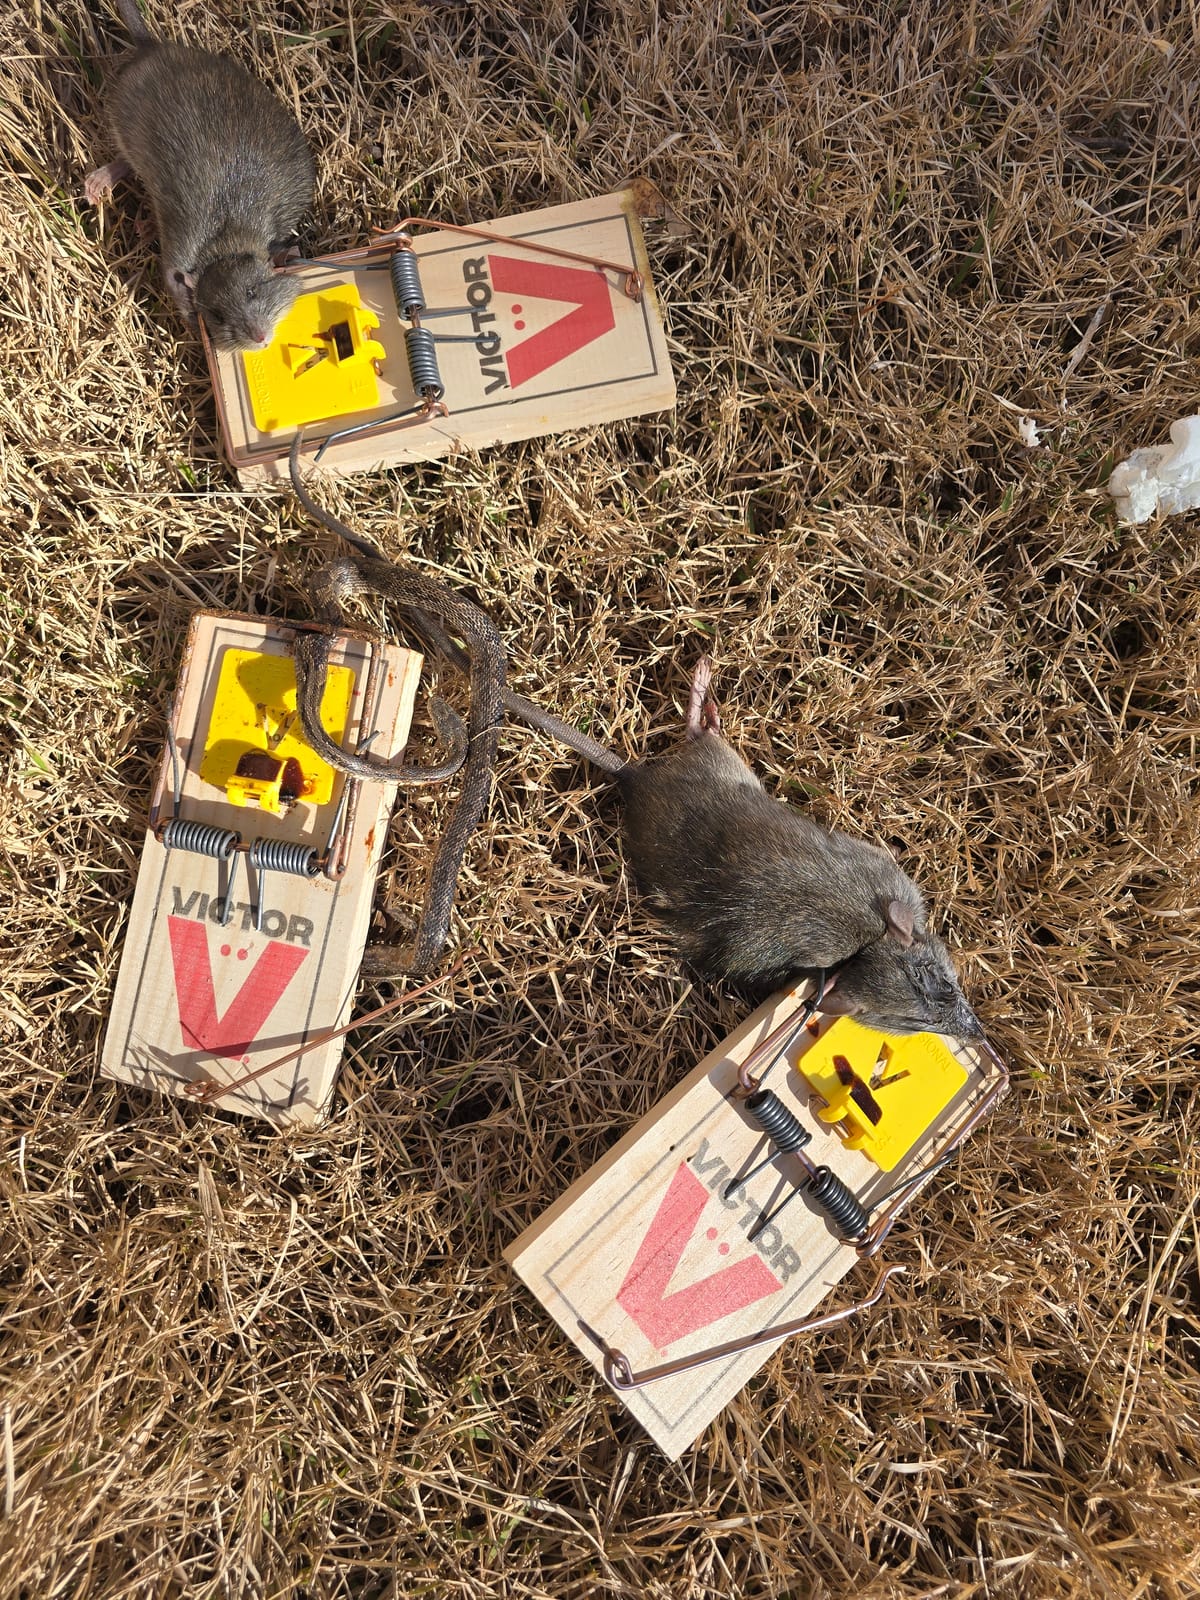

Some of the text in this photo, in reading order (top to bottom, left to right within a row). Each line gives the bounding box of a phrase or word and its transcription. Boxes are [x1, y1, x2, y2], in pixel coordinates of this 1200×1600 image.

[463, 256, 508, 395] VICTOR
[172, 885, 314, 946] VICTOR
[691, 1136, 802, 1284] VICTOR
